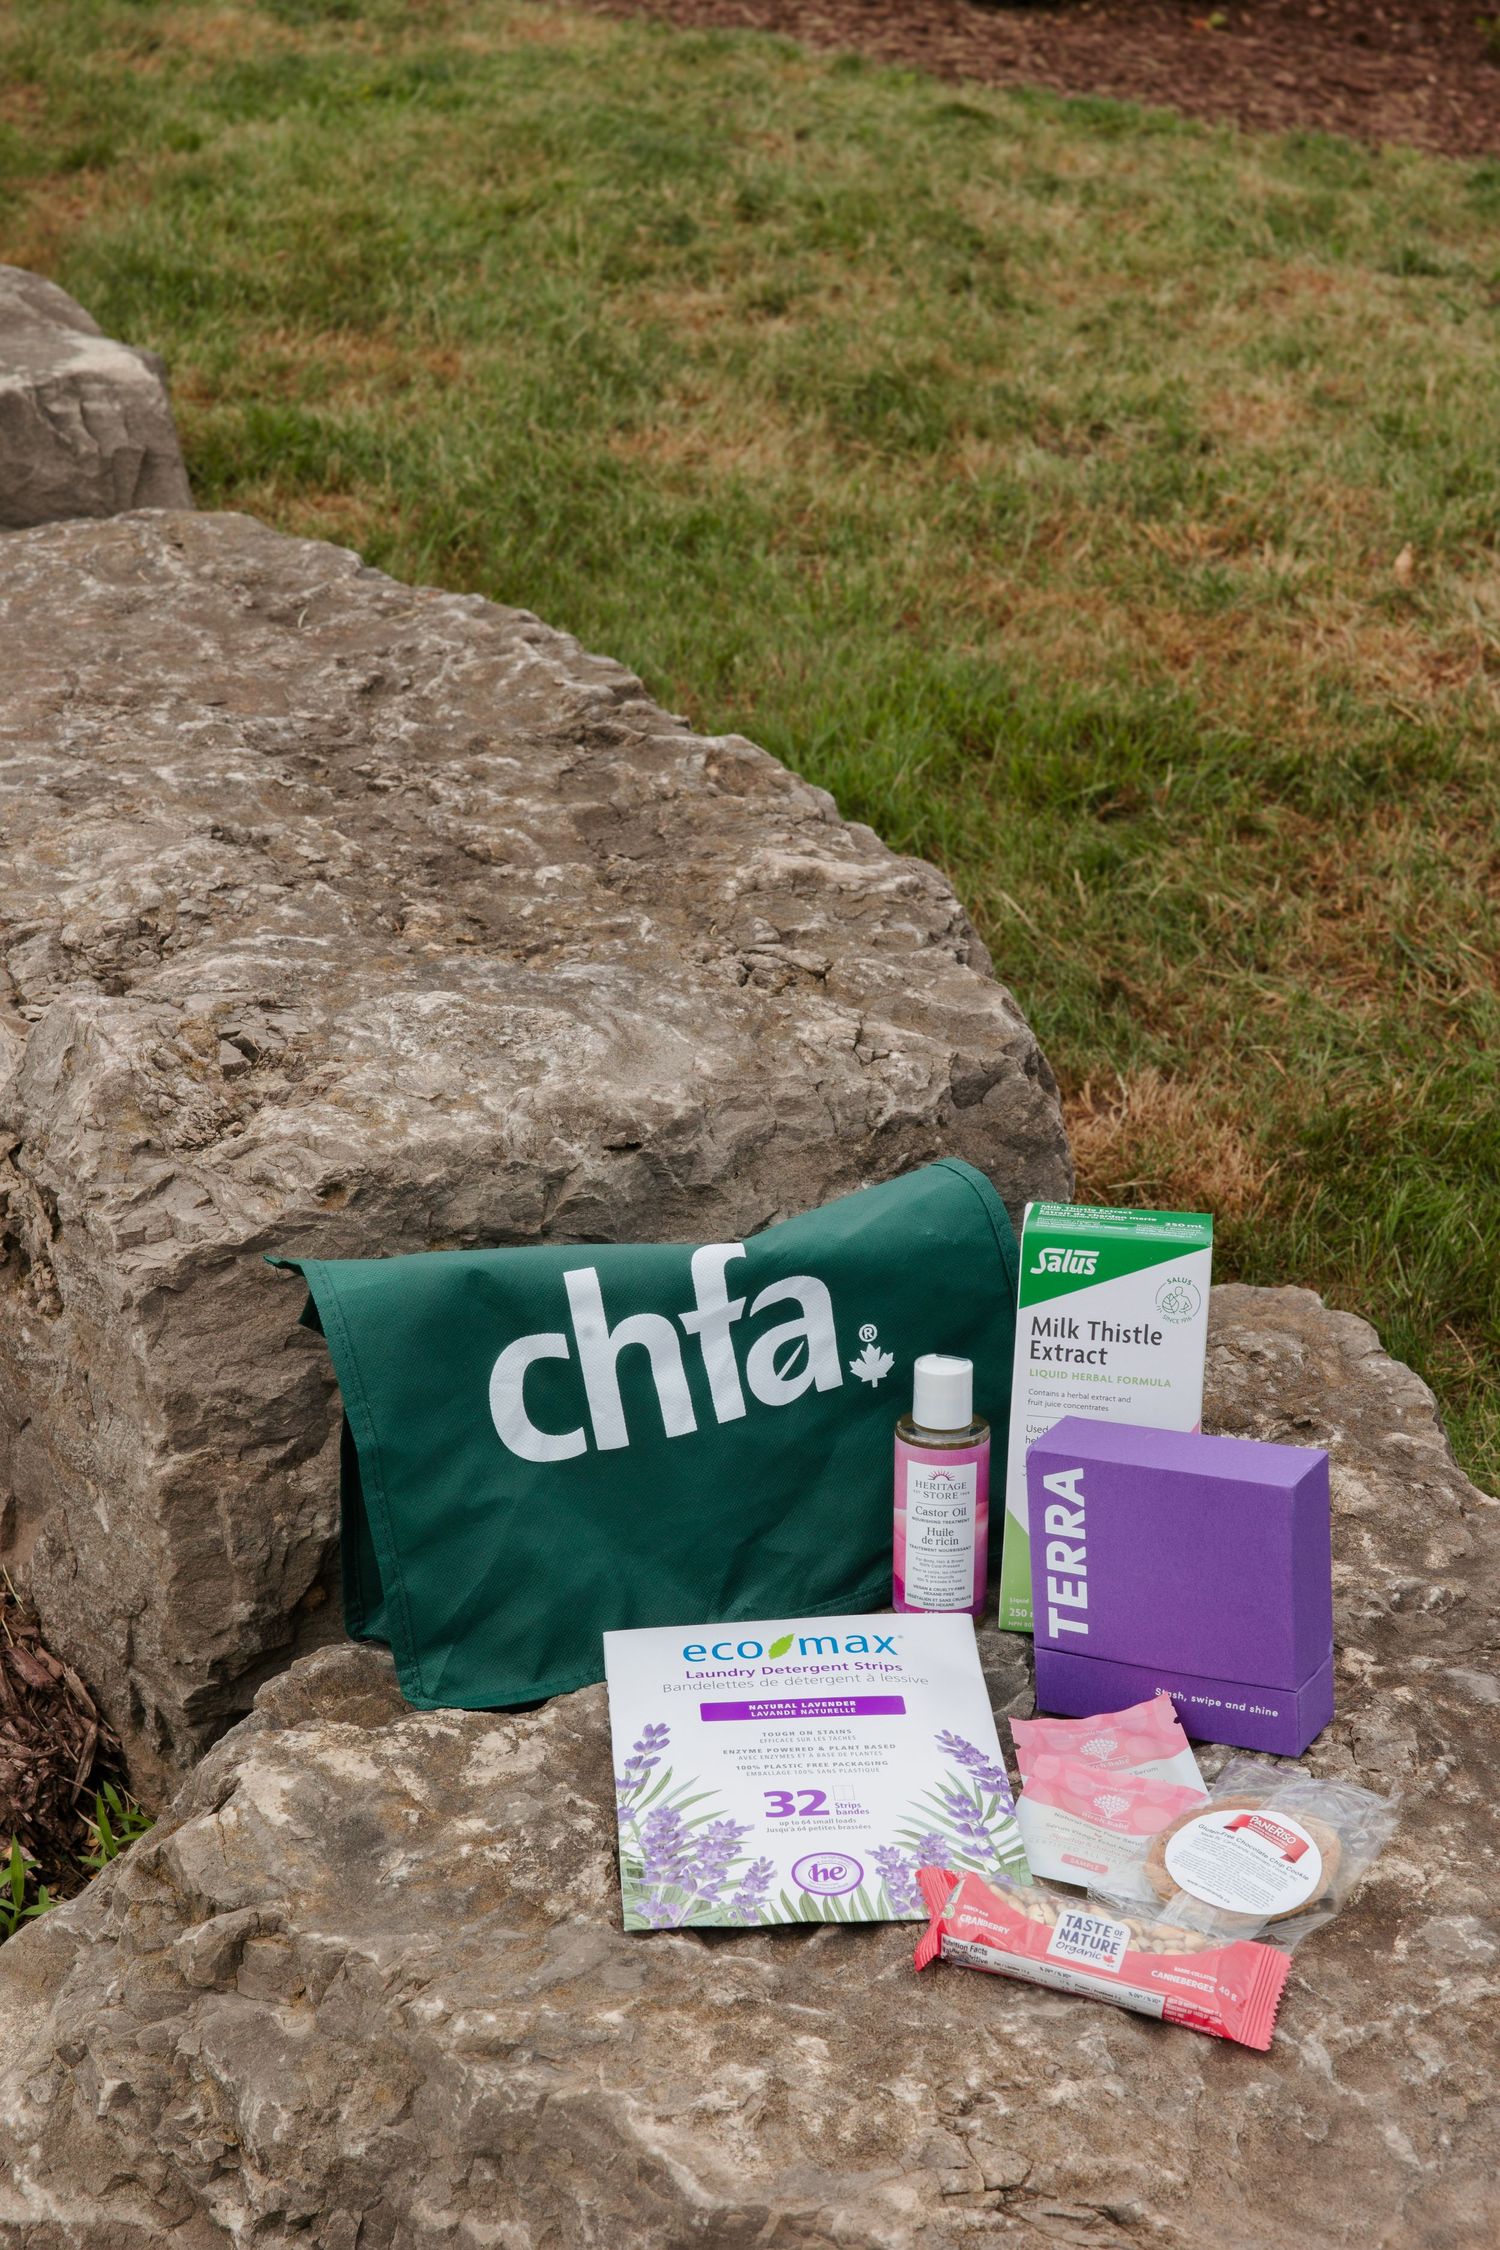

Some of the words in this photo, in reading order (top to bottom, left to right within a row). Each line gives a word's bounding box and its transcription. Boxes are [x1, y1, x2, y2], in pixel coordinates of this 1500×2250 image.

[1030, 1248, 1100, 1275] Salus
[1167, 1277, 1192, 1286] SALUS
[1031, 1316, 1079, 1339] Milk
[1087, 1320, 1163, 1346] Thistle
[489, 1242, 844, 1462] chfa
[1029, 1340, 1108, 1365] Extract
[1029, 1368, 1068, 1380] LIQUID
[1071, 1372, 1114, 1384] HERBAL
[1117, 1375, 1171, 1388] FORMULA
[1028, 1388, 1059, 1398] Contains
[1067, 1391, 1090, 1400] herbal
[1091, 1394, 1116, 1403] extract
[1027, 1399, 1043, 1407] fruit
[1044, 1400, 1062, 1408] juice
[1063, 1402, 1109, 1412] concentrates
[1026, 1424, 1048, 1433] Used
[915, 1480, 967, 1491] HERITAGE
[923, 1490, 959, 1500] STORE
[915, 1505, 949, 1518] Castor
[952, 1506, 967, 1517] Oil
[927, 1527, 954, 1537] Huile
[922, 1536, 933, 1545] de
[935, 1537, 959, 1546] ricin
[1043, 1467, 1089, 1638] TERRA
[1009, 1607, 1028, 1618] 250
[686, 1668, 755, 1679] Laundry
[762, 1662, 849, 1676] Detergent
[854, 1661, 904, 1672] Strips
[663, 1680, 754, 1693] Bandelettes
[760, 1678, 779, 1687] de
[784, 1673, 860, 1687] détergent
[867, 1673, 875, 1682] à
[881, 1673, 929, 1686] lessive
[748, 1702, 797, 1711] NATURAL
[801, 1700, 857, 1708] LAVENDER
[751, 1709, 797, 1717] LAVANDE
[800, 1707, 857, 1715] NATURELLE
[1191, 1695, 1222, 1707] swipe
[1225, 1702, 1246, 1711] and
[1249, 1705, 1279, 1717] shine
[746, 1769, 790, 1777] EMBALLAGE
[763, 1789, 830, 1818] 32
[834, 1802, 862, 1810] Strips
[836, 1808, 870, 1816] bandes
[1070, 1857, 1101, 1871] SAMPLE
[1236, 1837, 1269, 1859] Chocolate
[1269, 1857, 1285, 1869] Chip
[1285, 1865, 1310, 1881] Cookie
[810, 1863, 845, 1883] he
[959, 1913, 1011, 1935] CRANBERRY
[1066, 1914, 1113, 1938] TASTE
[1113, 1929, 1125, 1938] OF
[1058, 1928, 1121, 1956] NATURE
[969, 1943, 988, 1957] Facts
[1056, 1941, 1102, 1960] Organic
[1151, 1970, 1215, 1994] CANNEBERGES
[1218, 1985, 1231, 1997] 40
